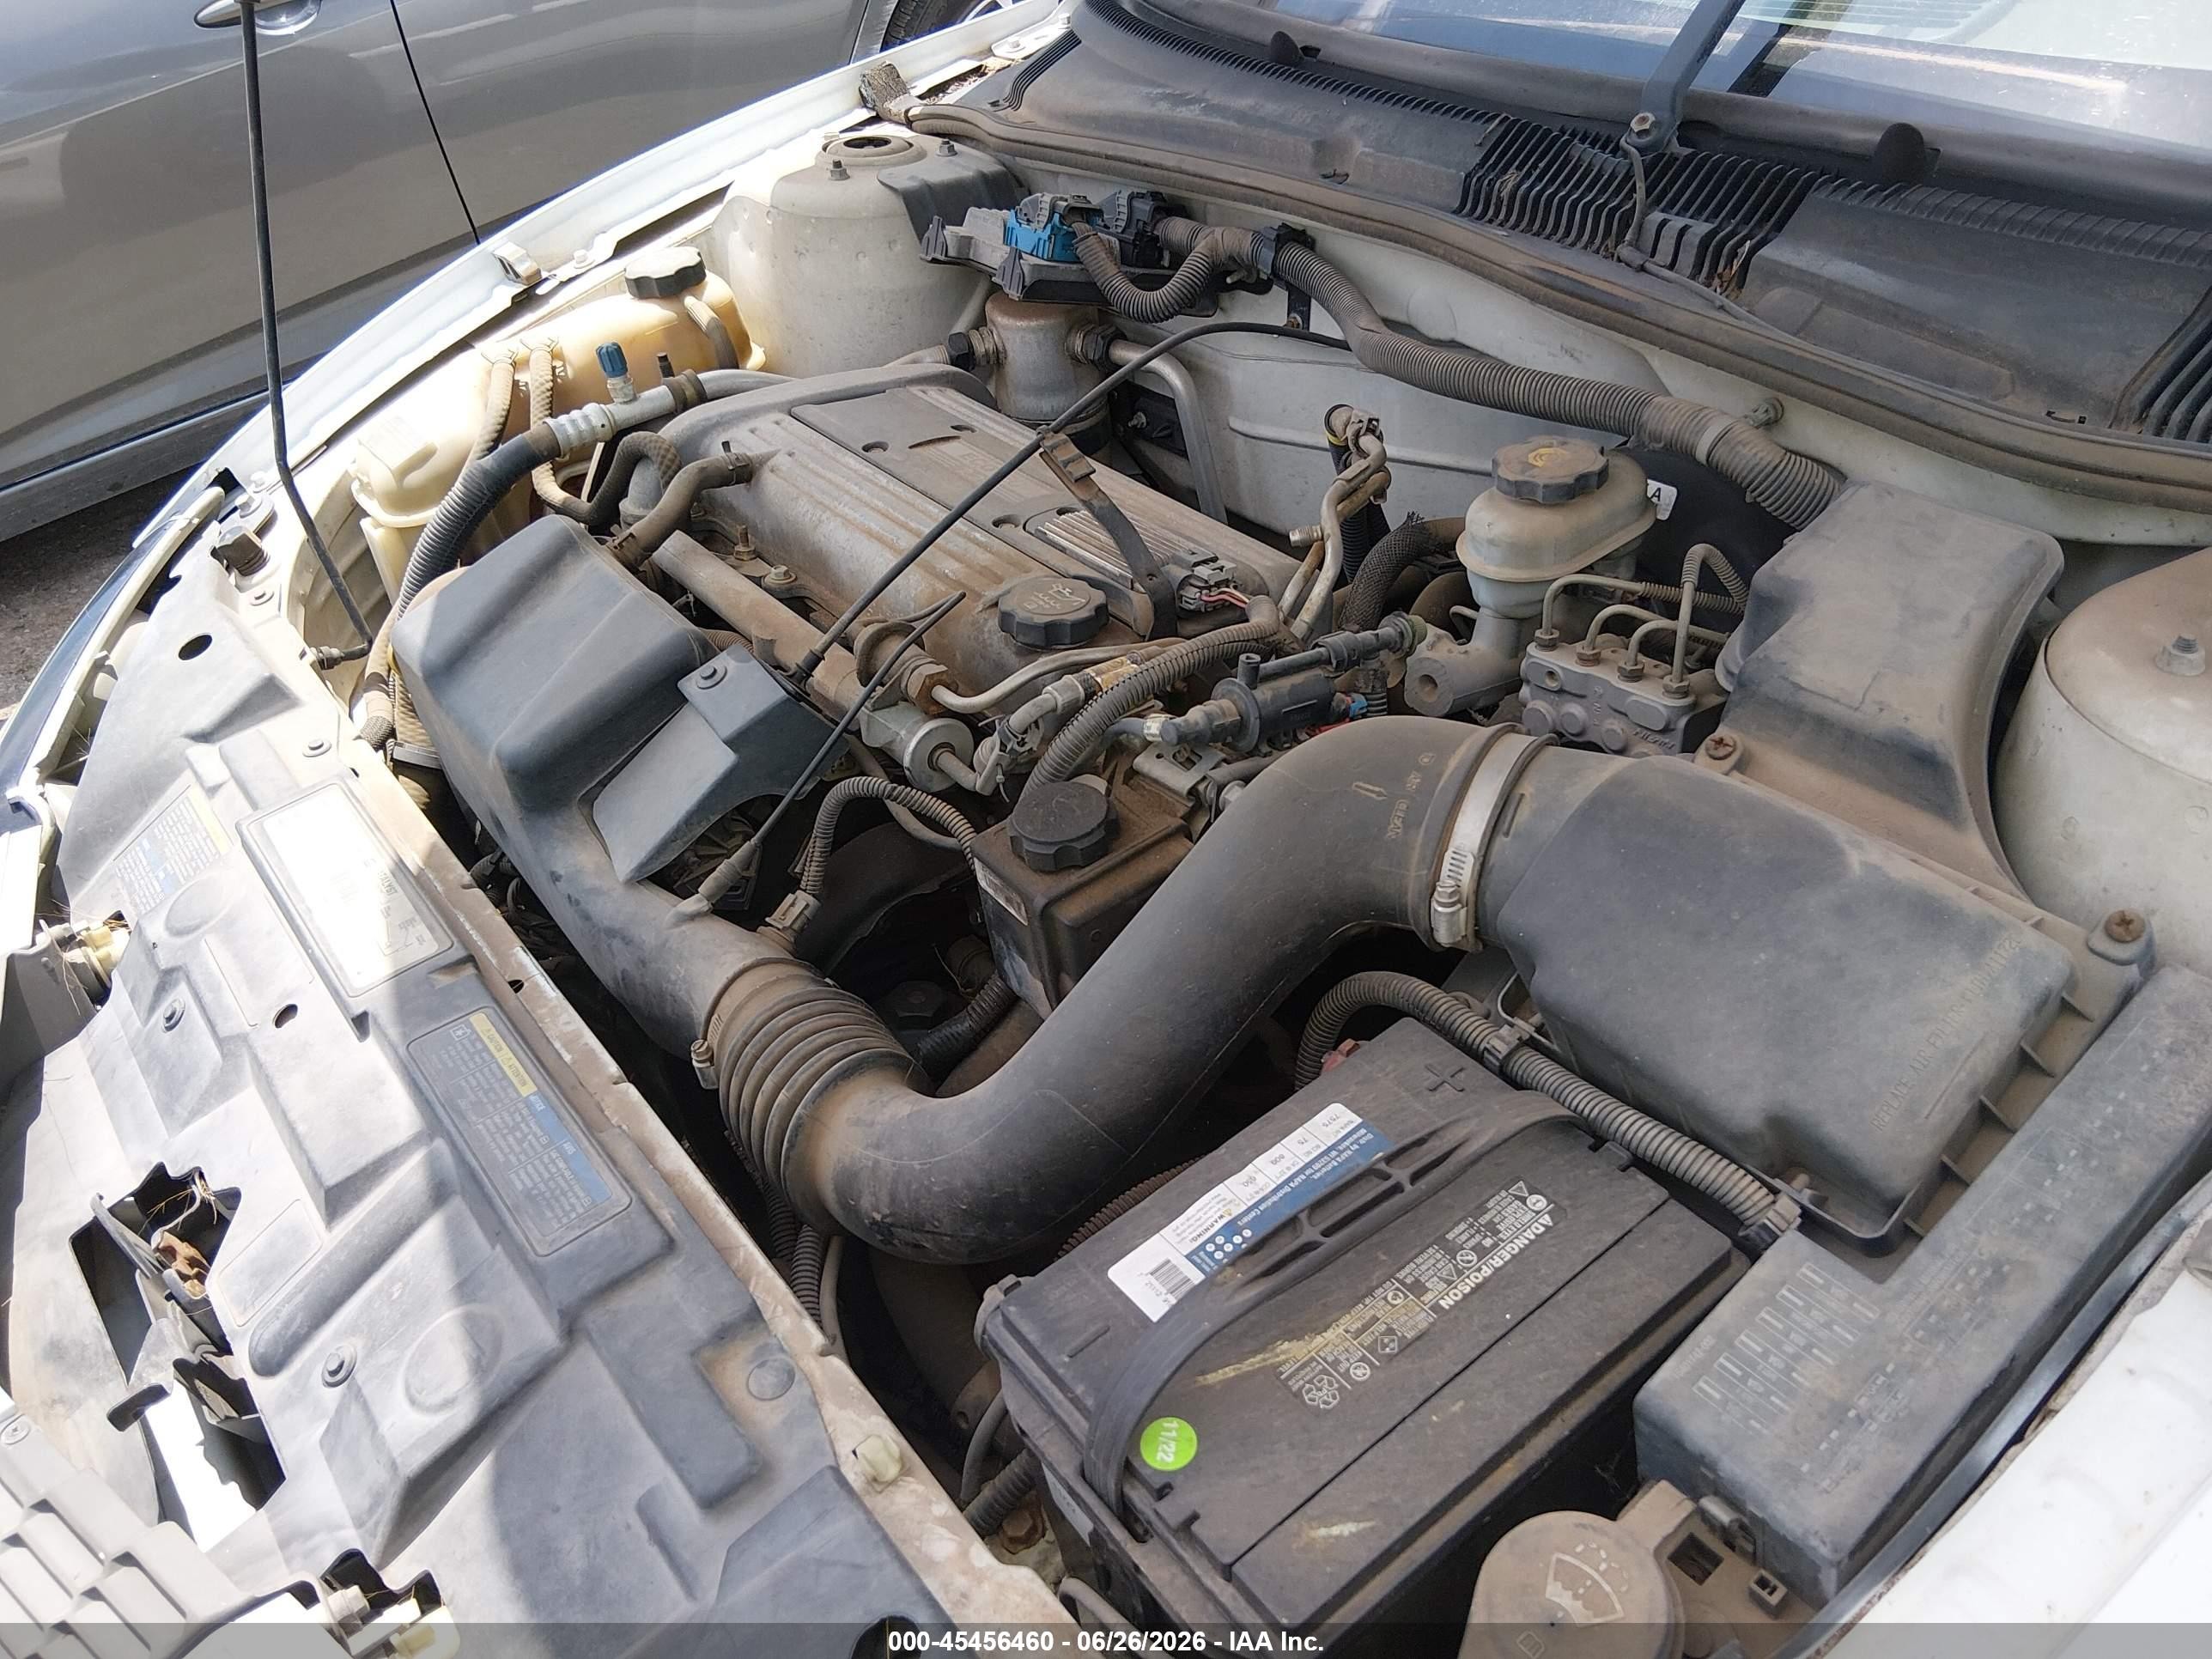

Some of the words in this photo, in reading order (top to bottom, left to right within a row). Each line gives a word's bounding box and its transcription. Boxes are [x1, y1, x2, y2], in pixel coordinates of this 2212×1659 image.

[1650, 487, 1662, 502] A
[1320, 1112, 1340, 1128] 7575
[1295, 1135, 1309, 1146] 75
[1286, 1172, 1308, 1188] NAPA
[1255, 1184, 1291, 1212] Distribution
[1235, 1206, 1261, 1227] Centers
[1499, 1199, 1522, 1218] GASES
[1494, 1203, 1528, 1232] EXPLOSIVE
[1511, 1208, 1536, 1229] SHIELD
[1480, 1235, 1494, 1248] NO
[1433, 1256, 1449, 1270] CAN
[1437, 1219, 1547, 1310] DANGER/POISON
[1346, 1348, 1364, 1364] KEEP
[1334, 1358, 1351, 1372] OUT
[1156, 1420, 1179, 1462] 11/22
